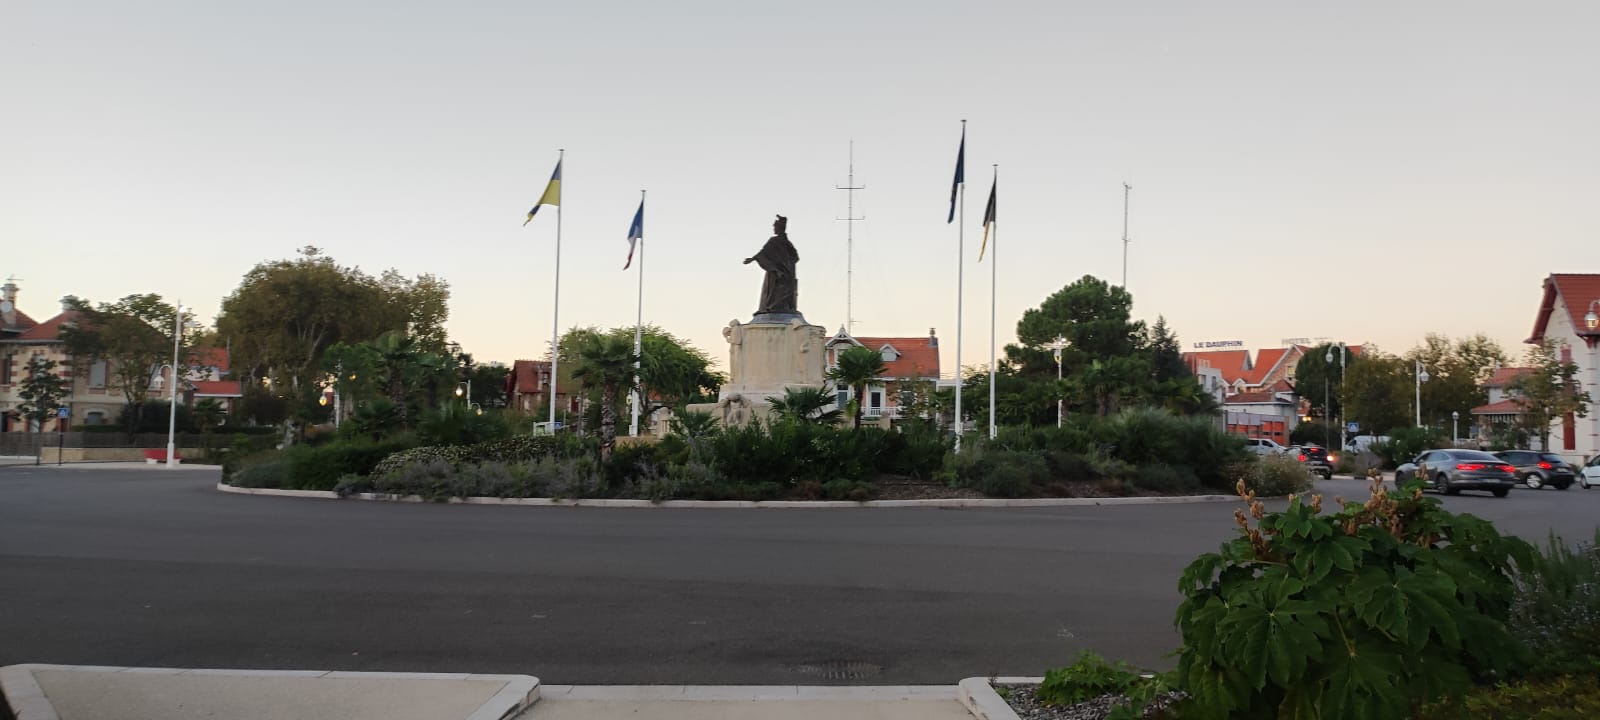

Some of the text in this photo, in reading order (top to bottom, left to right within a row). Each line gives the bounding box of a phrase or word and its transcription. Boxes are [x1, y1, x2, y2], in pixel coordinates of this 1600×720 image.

[1194, 340, 1243, 349] LE DAUPHIN
[1282, 337, 1311, 345] HOTEL
